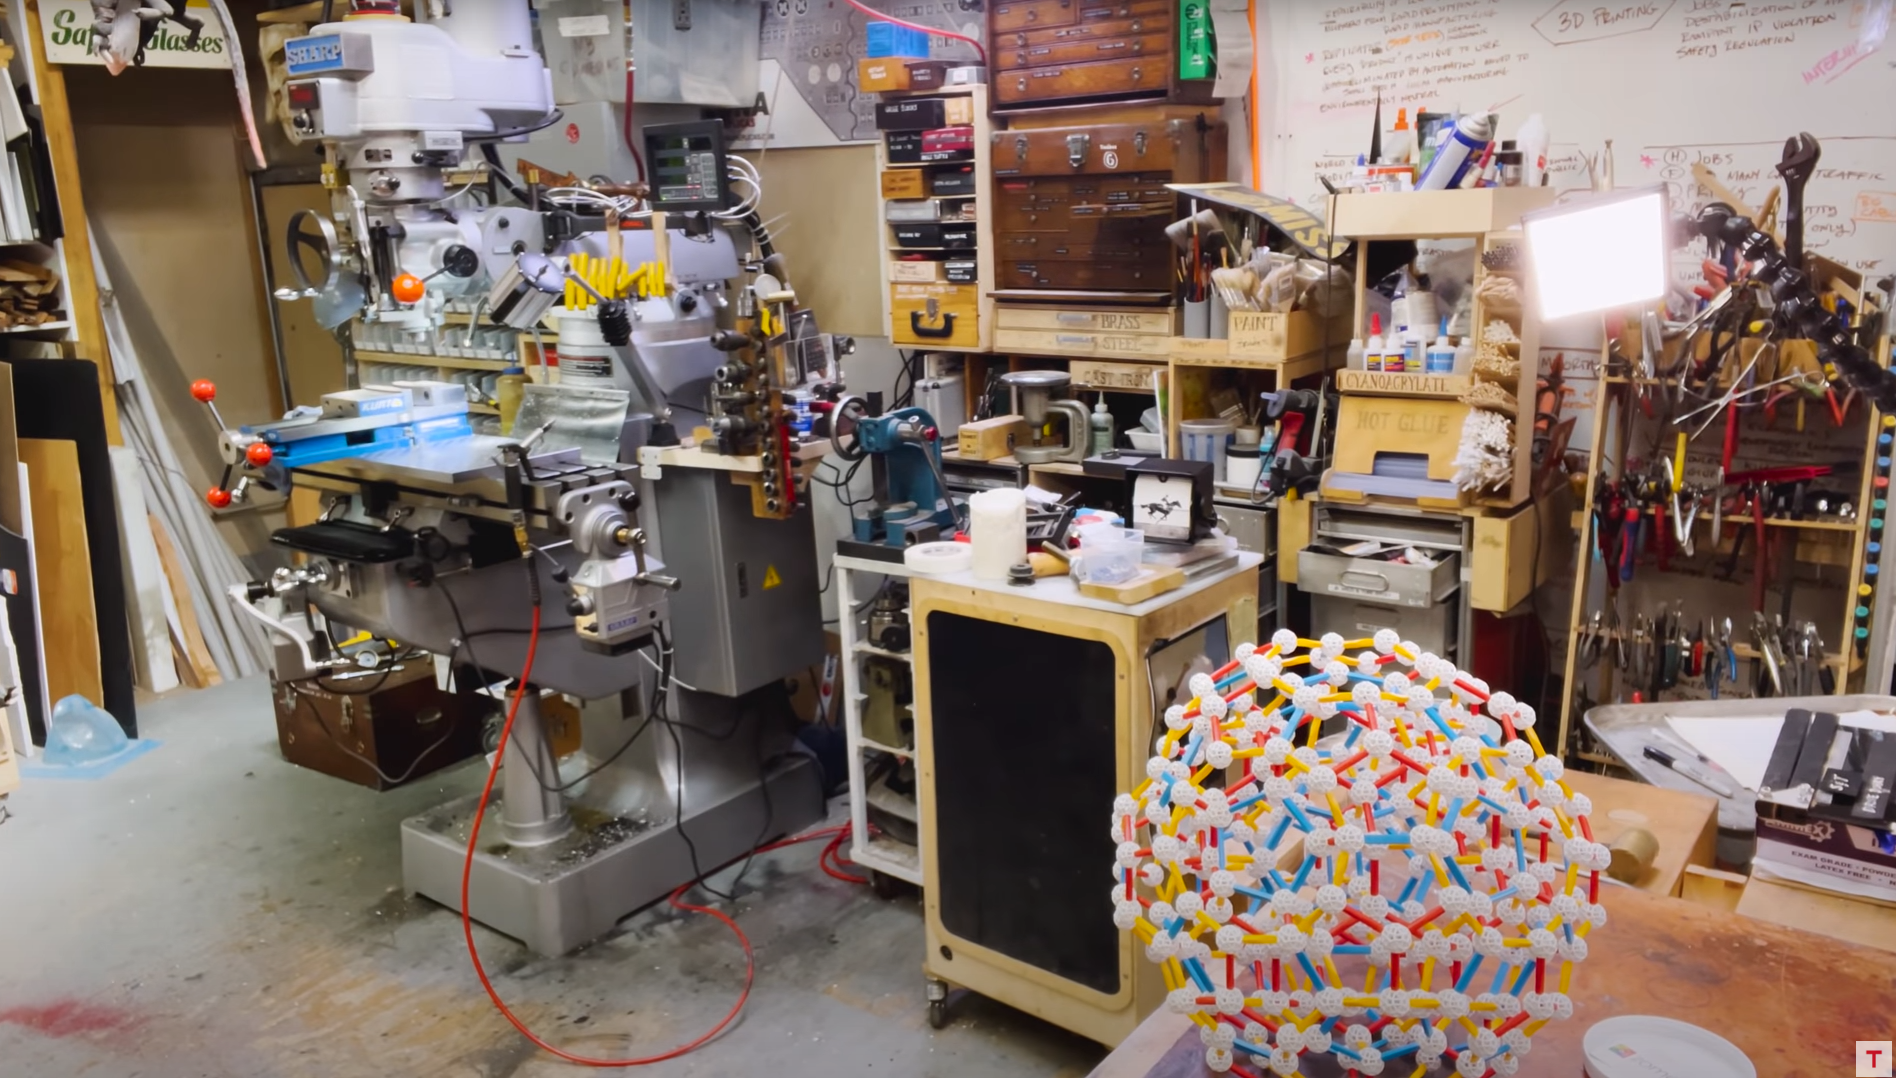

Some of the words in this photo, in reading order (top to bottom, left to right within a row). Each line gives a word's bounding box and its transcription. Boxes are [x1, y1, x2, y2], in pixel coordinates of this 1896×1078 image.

[1558, 11, 1585, 33] 3D
[1592, 2, 1660, 27] PRINTING
[286, 43, 342, 66] SHARP
[1726, 169, 1761, 181] MANY
[1101, 313, 1141, 330] BRASS
[1233, 315, 1279, 332] PAINT
[1102, 335, 1142, 351] STEEL
[1083, 369, 1115, 386] CAST
[1346, 372, 1450, 393] CYANOACRYLATE
[1356, 410, 1392, 431] HOT
[1397, 413, 1450, 435] GLUE
[1790, 850, 1818, 861] EXAM
[1820, 856, 1855, 870] GRADE
[1814, 863, 1845, 875] LATEX
[1846, 870, 1872, 880] FREE
